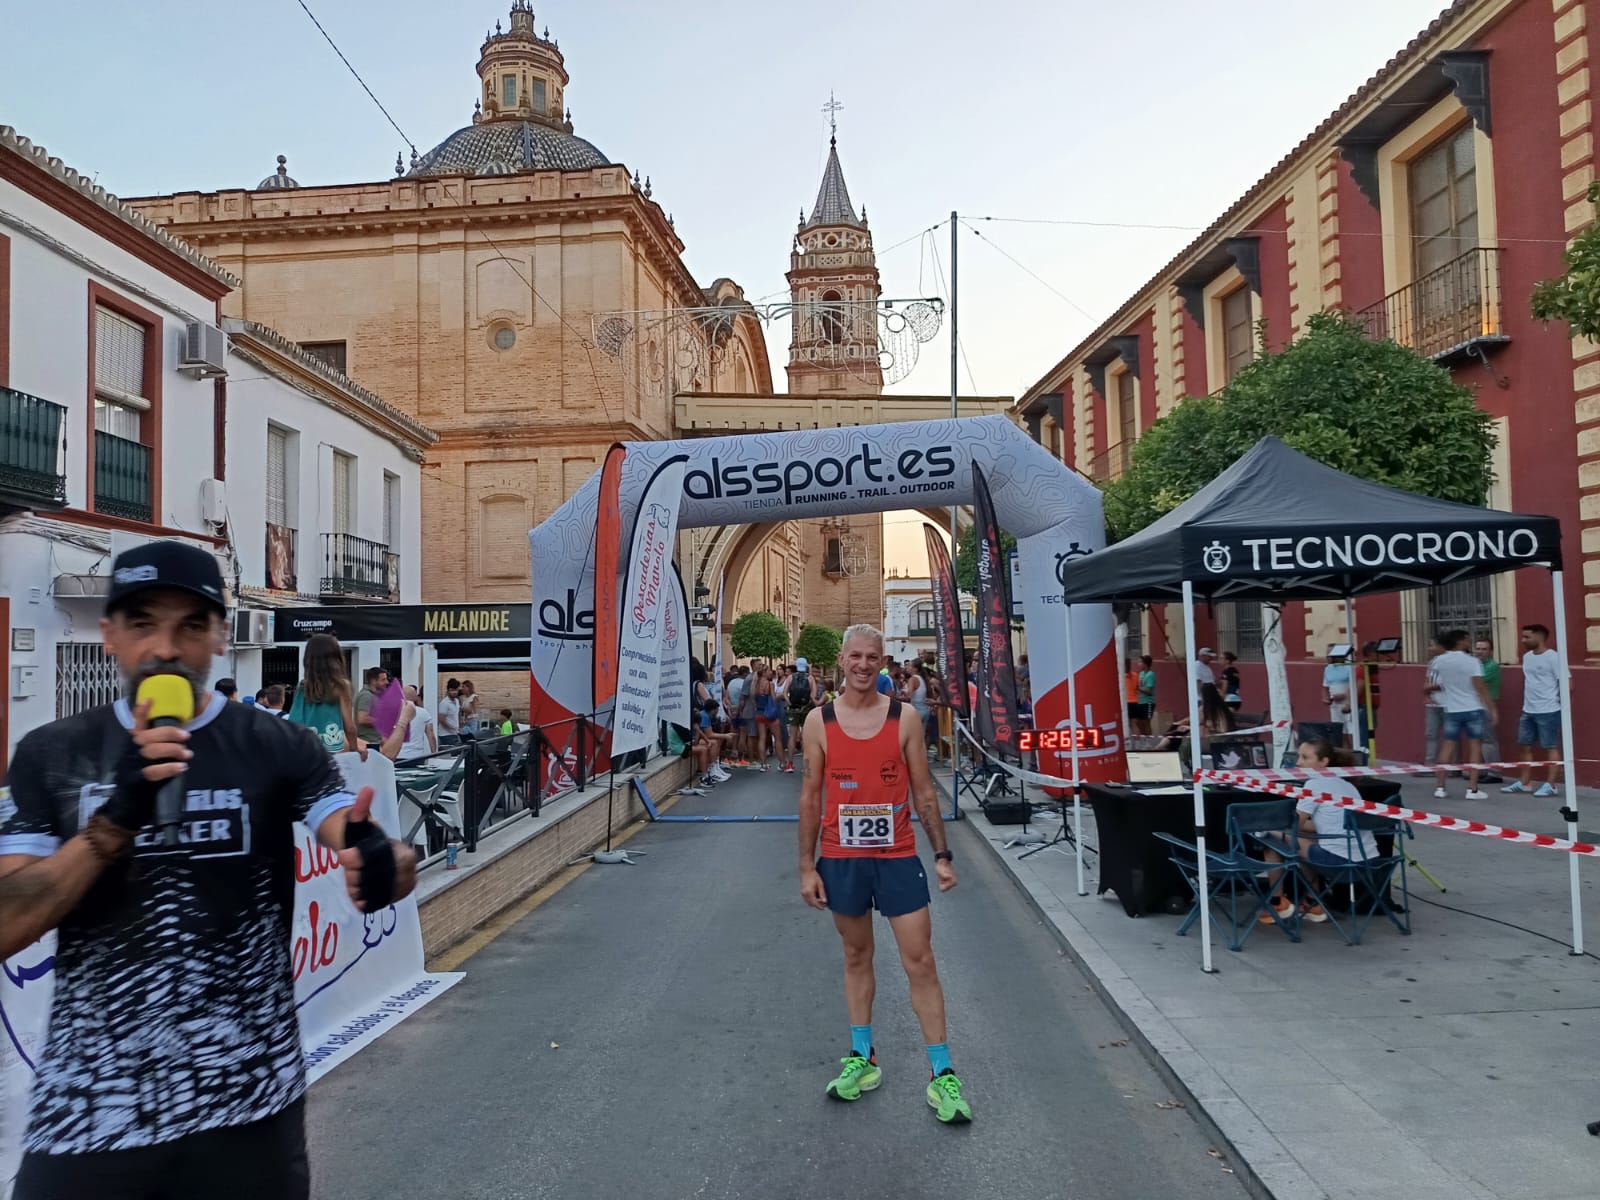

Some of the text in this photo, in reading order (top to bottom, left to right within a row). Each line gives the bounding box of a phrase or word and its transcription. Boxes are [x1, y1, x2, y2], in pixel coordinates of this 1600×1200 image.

[683, 444, 956, 505] alssport.es
[743, 481, 955, 510] TIENDA RUNNING TRAIL OUTDOOR
[1243, 528, 1539, 571] TECNOCRONO
[644, 541, 666, 606] Manolo
[293, 619, 333, 628] Cruzcampo
[424, 610, 510, 632] MALANDRE
[844, 817, 889, 838] 128
